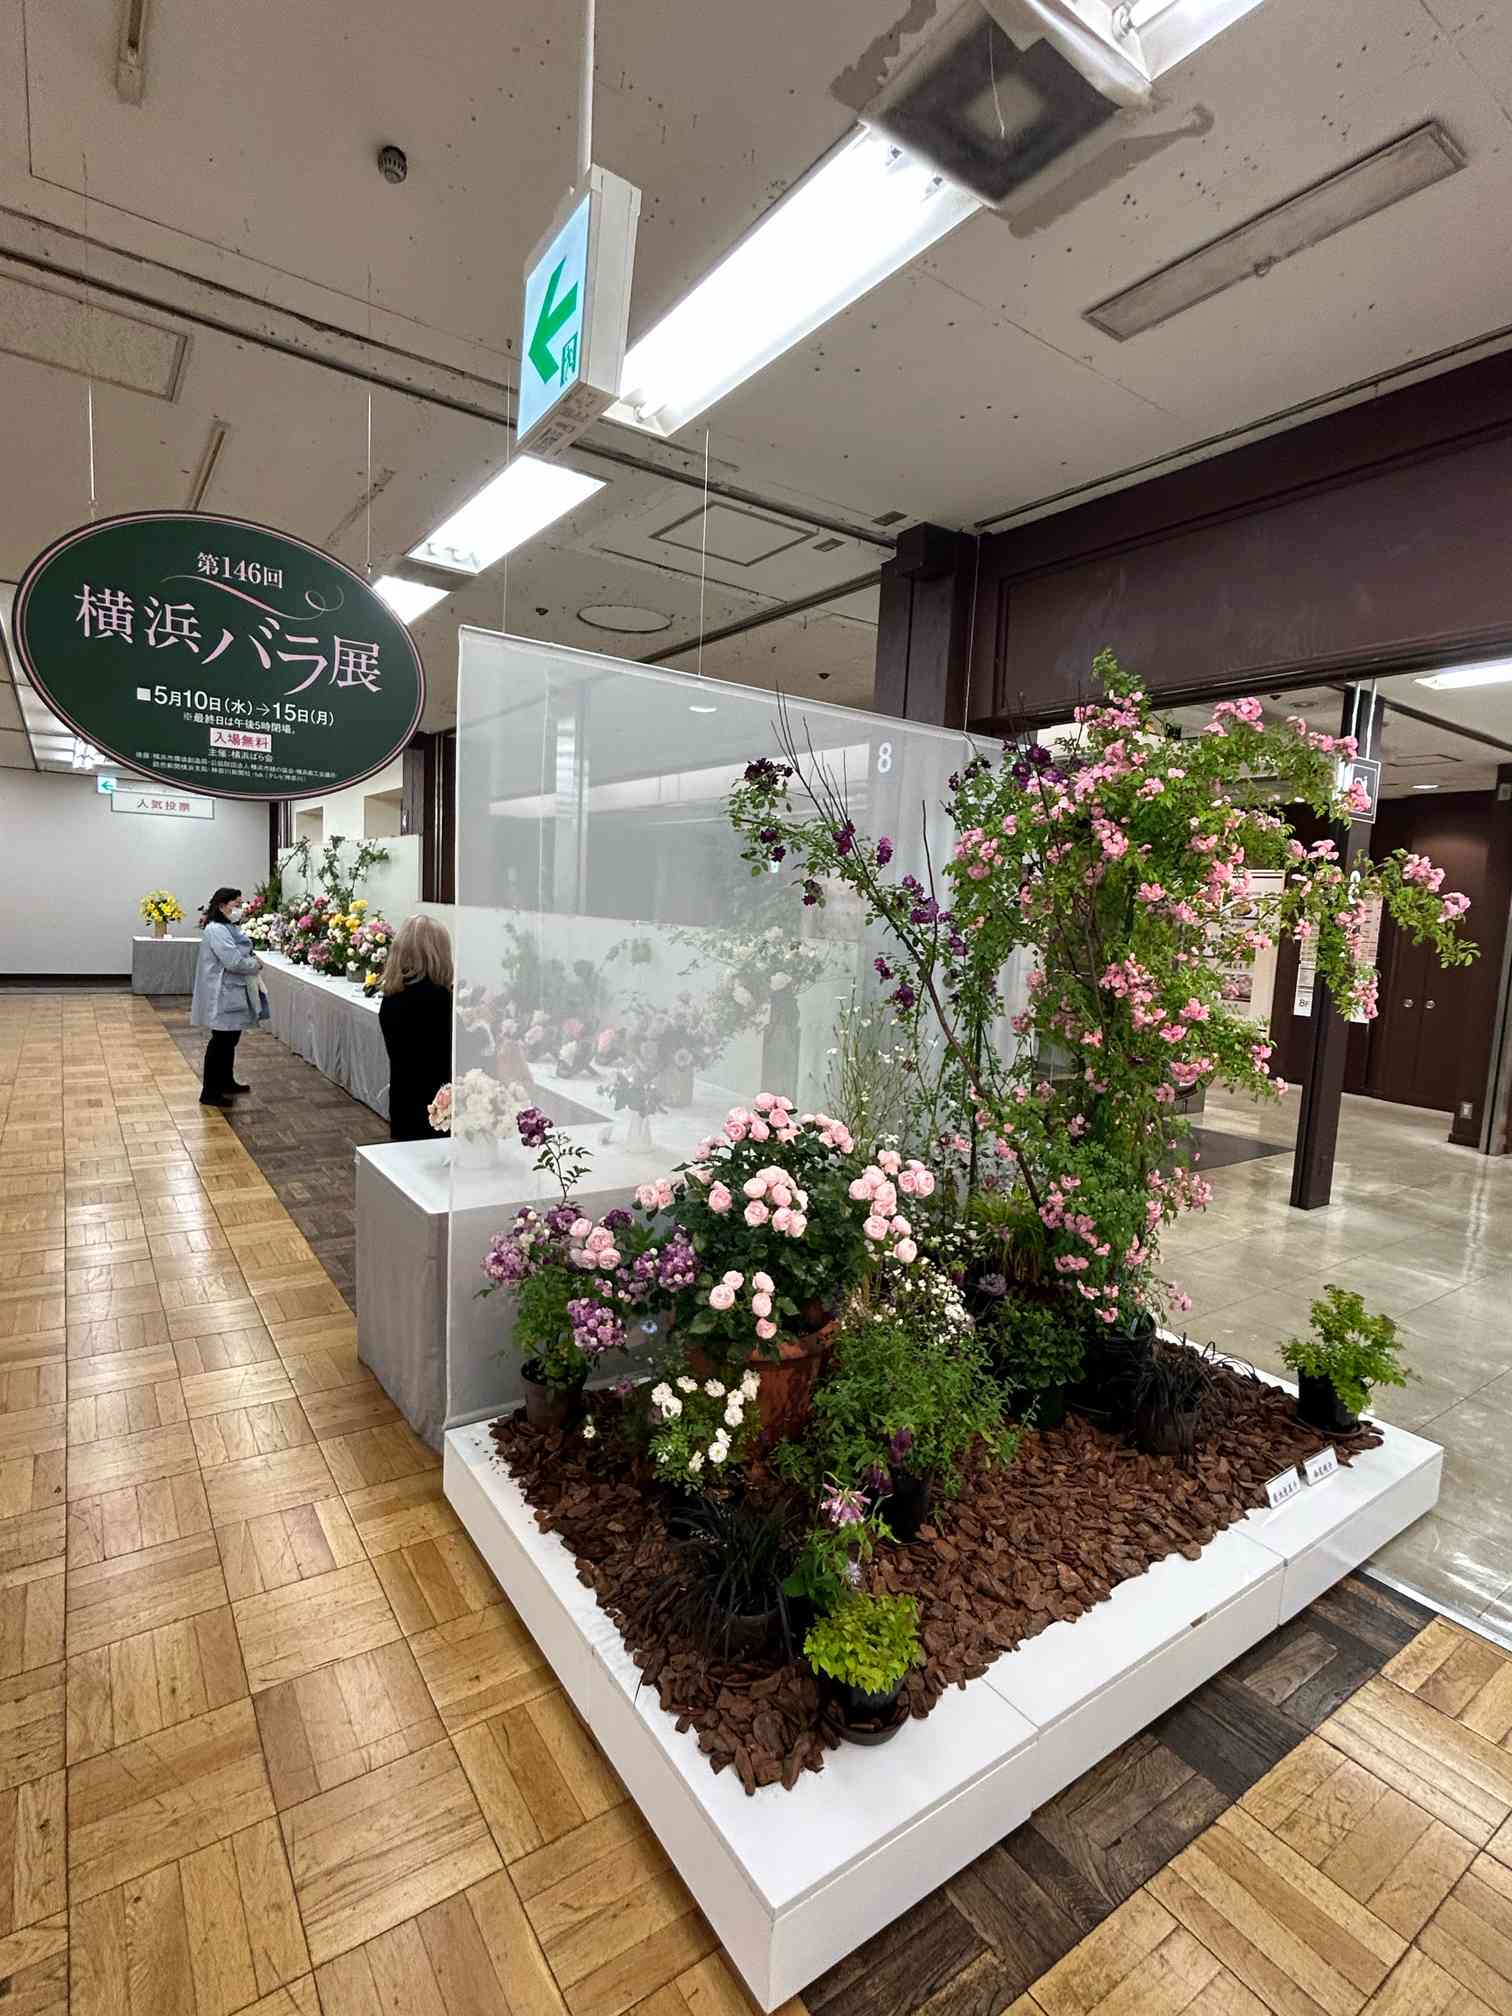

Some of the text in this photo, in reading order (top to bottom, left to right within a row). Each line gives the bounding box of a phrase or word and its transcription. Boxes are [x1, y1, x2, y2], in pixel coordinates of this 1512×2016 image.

[197, 552, 284, 589] 第146回
[74, 583, 383, 696] 横浜バラ展
[213, 733, 269, 748] 入場無料
[878, 742, 892, 773] 8
